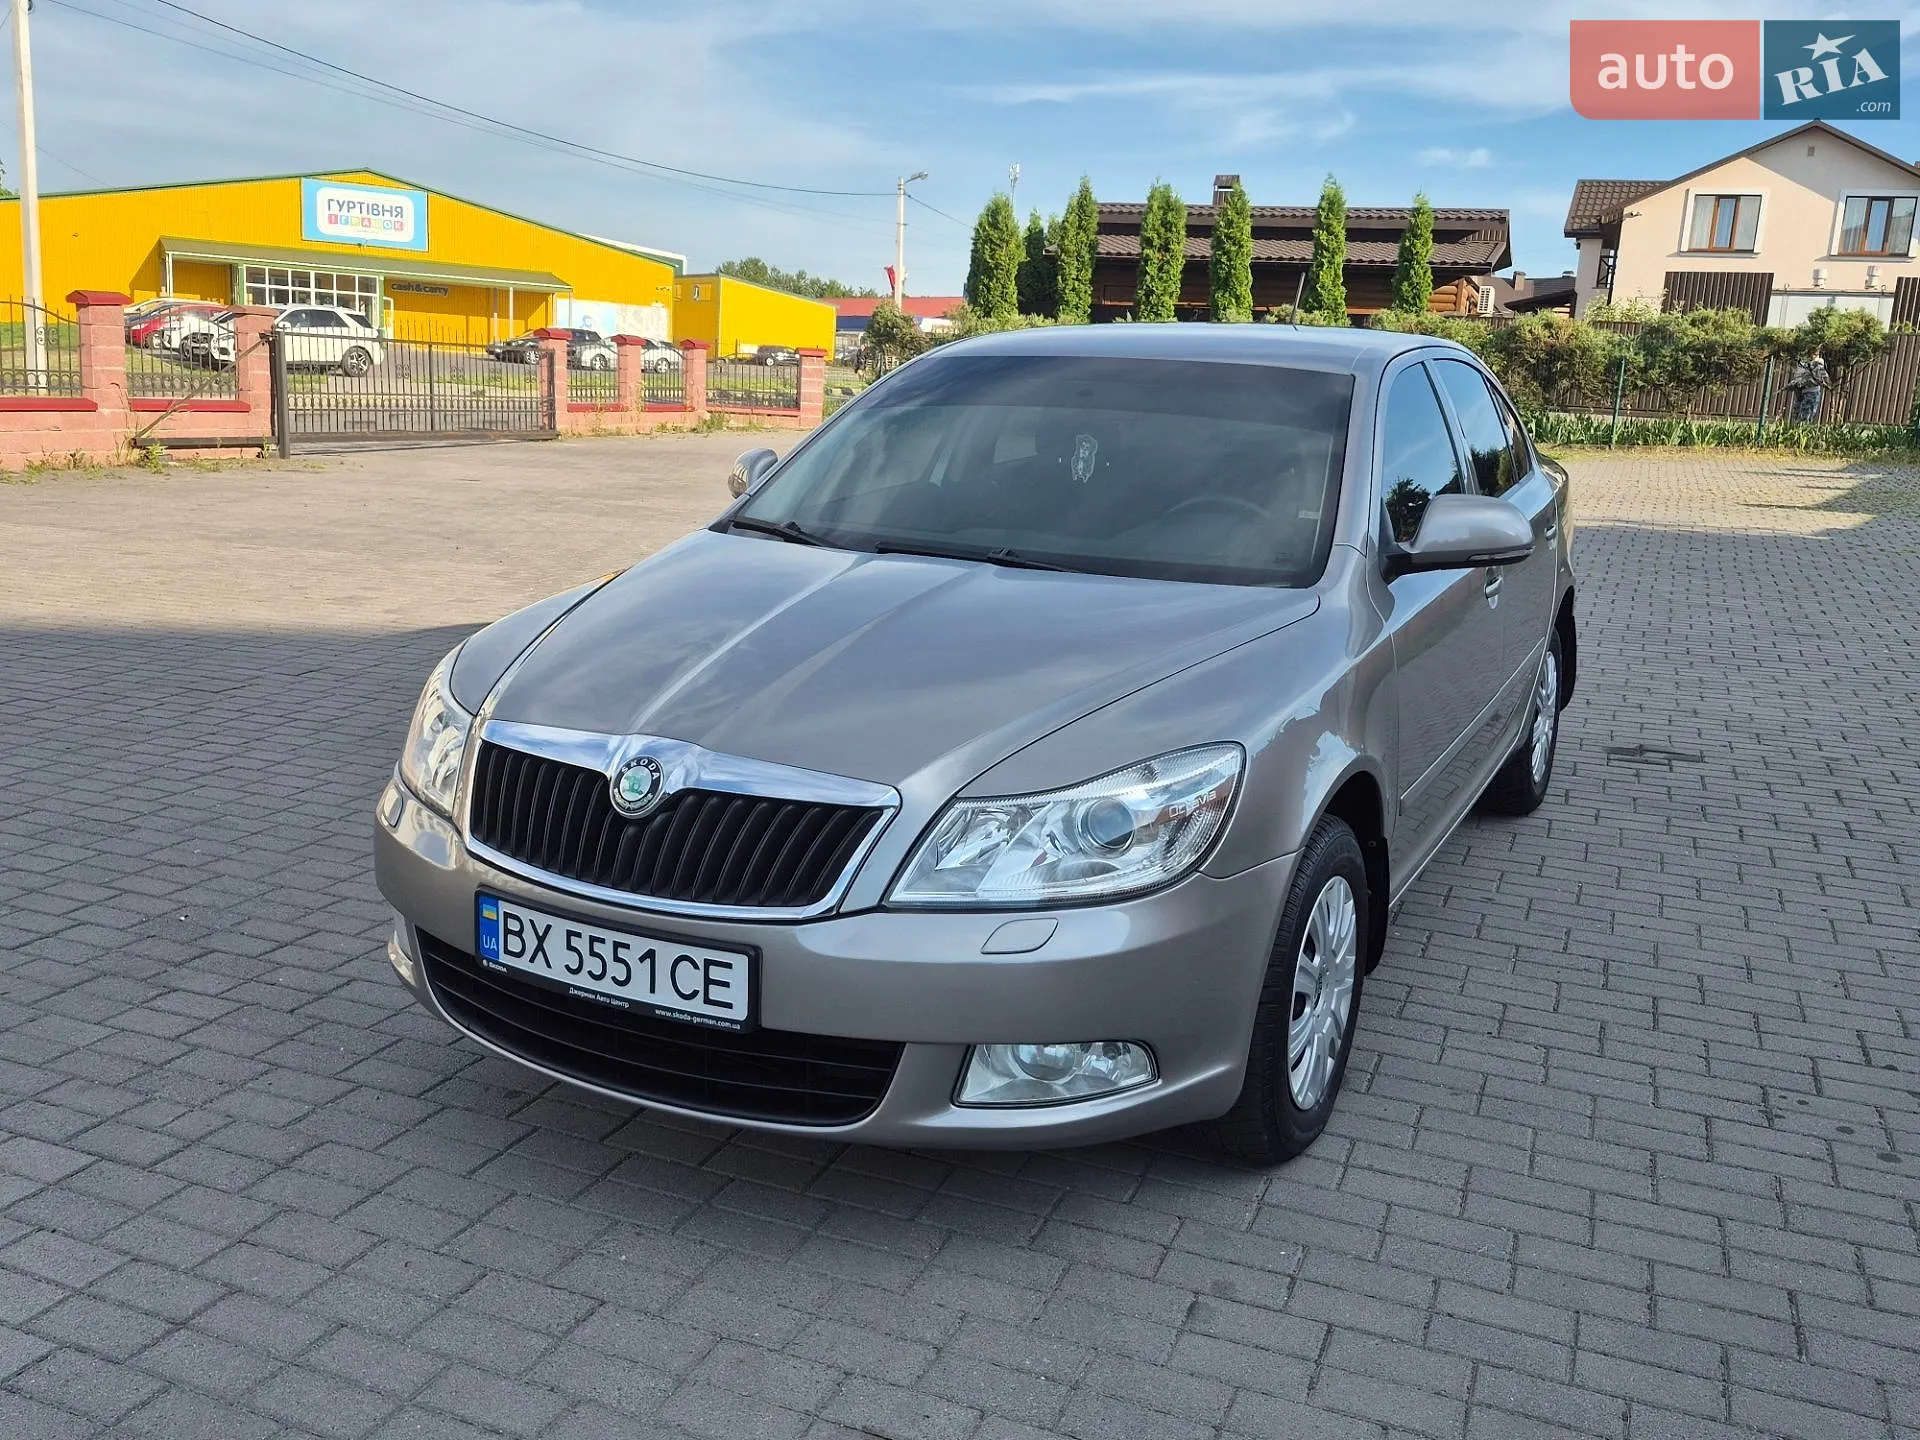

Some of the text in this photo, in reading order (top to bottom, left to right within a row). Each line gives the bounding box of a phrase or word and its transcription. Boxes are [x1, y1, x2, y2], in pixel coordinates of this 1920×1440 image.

[327, 198, 404, 219] ГУРТІВНЯ
[391, 282, 449, 296] cash&carry
[482, 934, 498, 951] UA
[503, 911, 734, 1010] BX 5551 CE
[654, 1008, 741, 1030] www.skoda-german.com.ua
